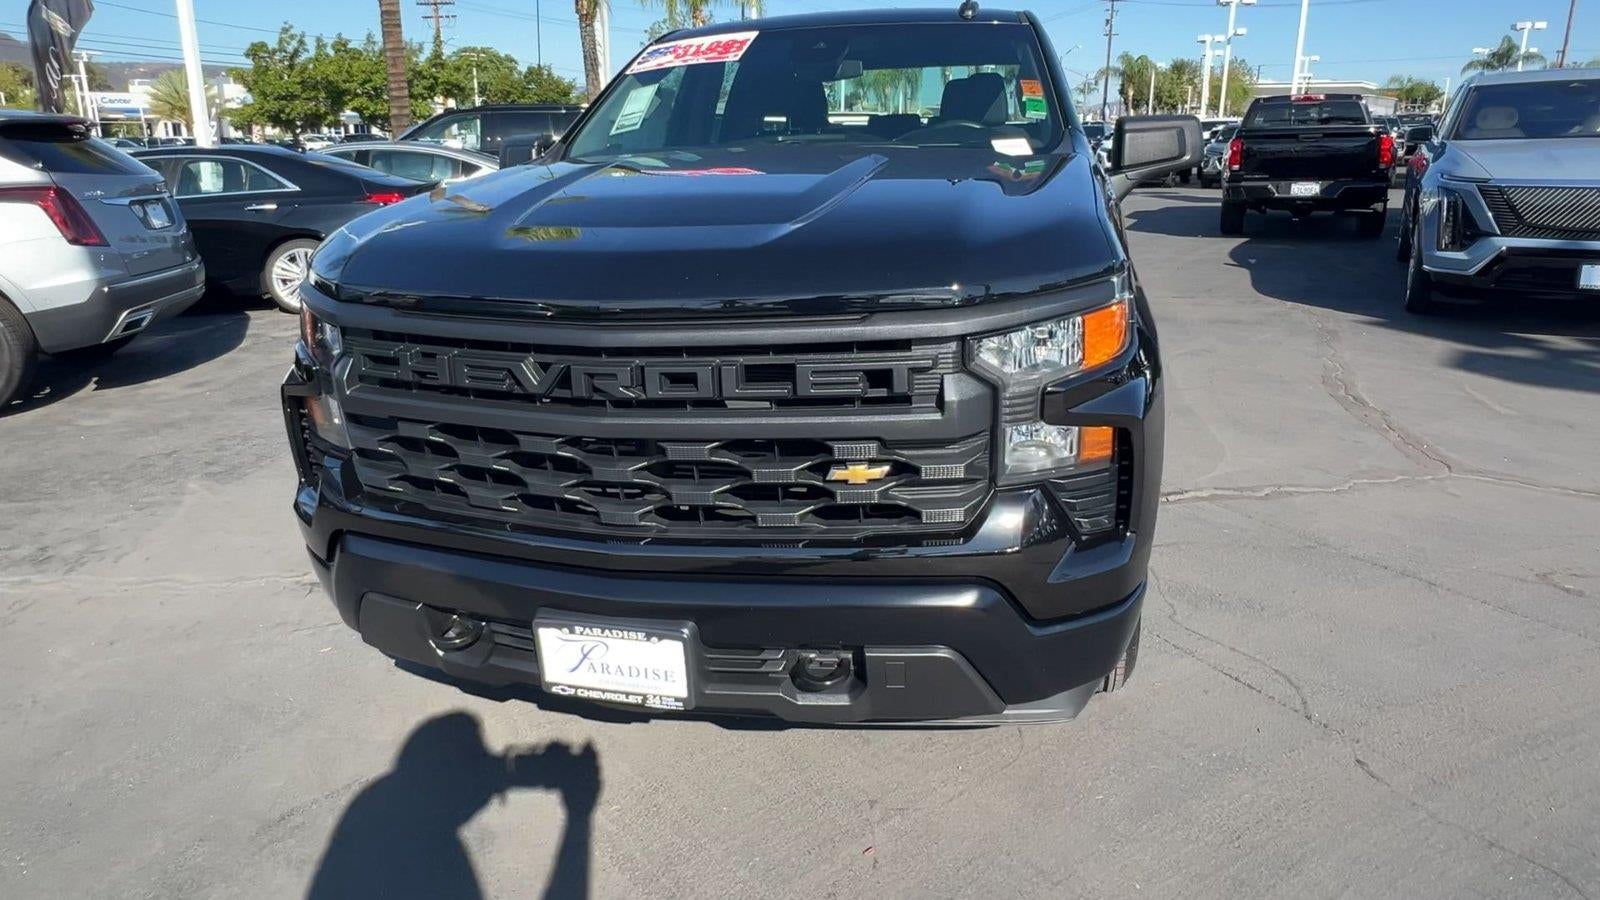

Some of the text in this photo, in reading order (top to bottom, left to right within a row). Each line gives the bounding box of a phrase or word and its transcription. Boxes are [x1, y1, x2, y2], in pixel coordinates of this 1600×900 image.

[342, 345, 939, 399] CHEVROLET
[574, 626, 647, 641] PARADISE
[558, 637, 676, 683] PARADISE
[577, 689, 660, 705] CHEVROLET 34
